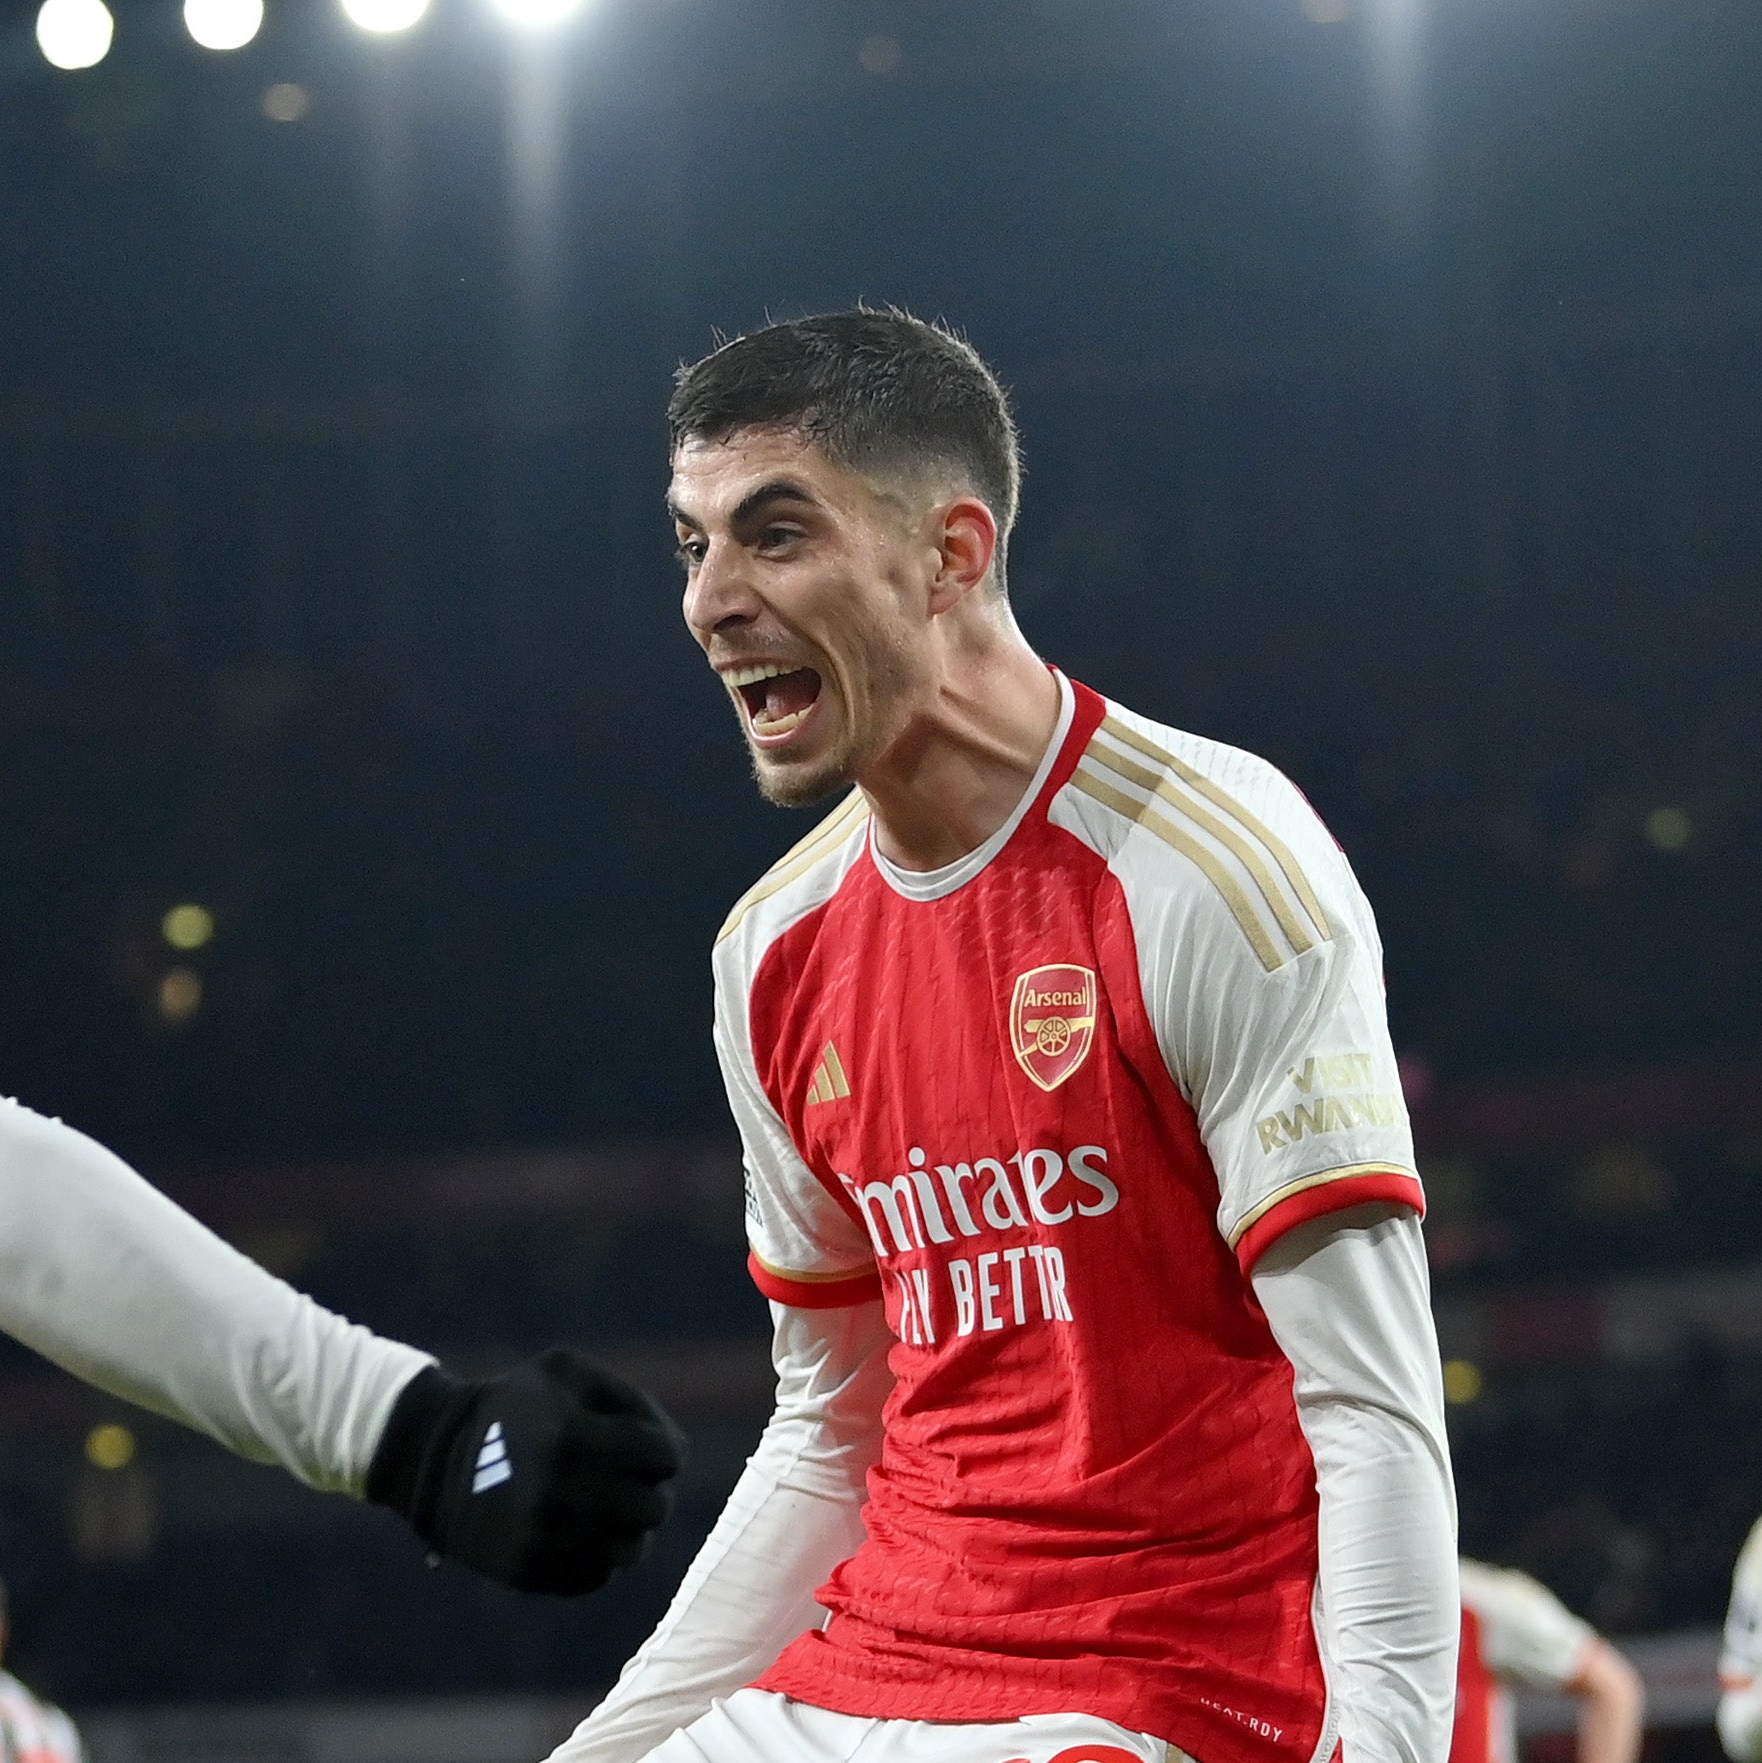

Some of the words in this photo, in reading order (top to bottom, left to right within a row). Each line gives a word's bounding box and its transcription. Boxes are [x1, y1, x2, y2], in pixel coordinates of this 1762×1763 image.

[1024, 986, 1087, 1008] Arsenal
[1255, 1092, 1401, 1155] RWAND
[837, 1145, 1120, 1257] mirates
[948, 1244, 1074, 1337] BETTR
